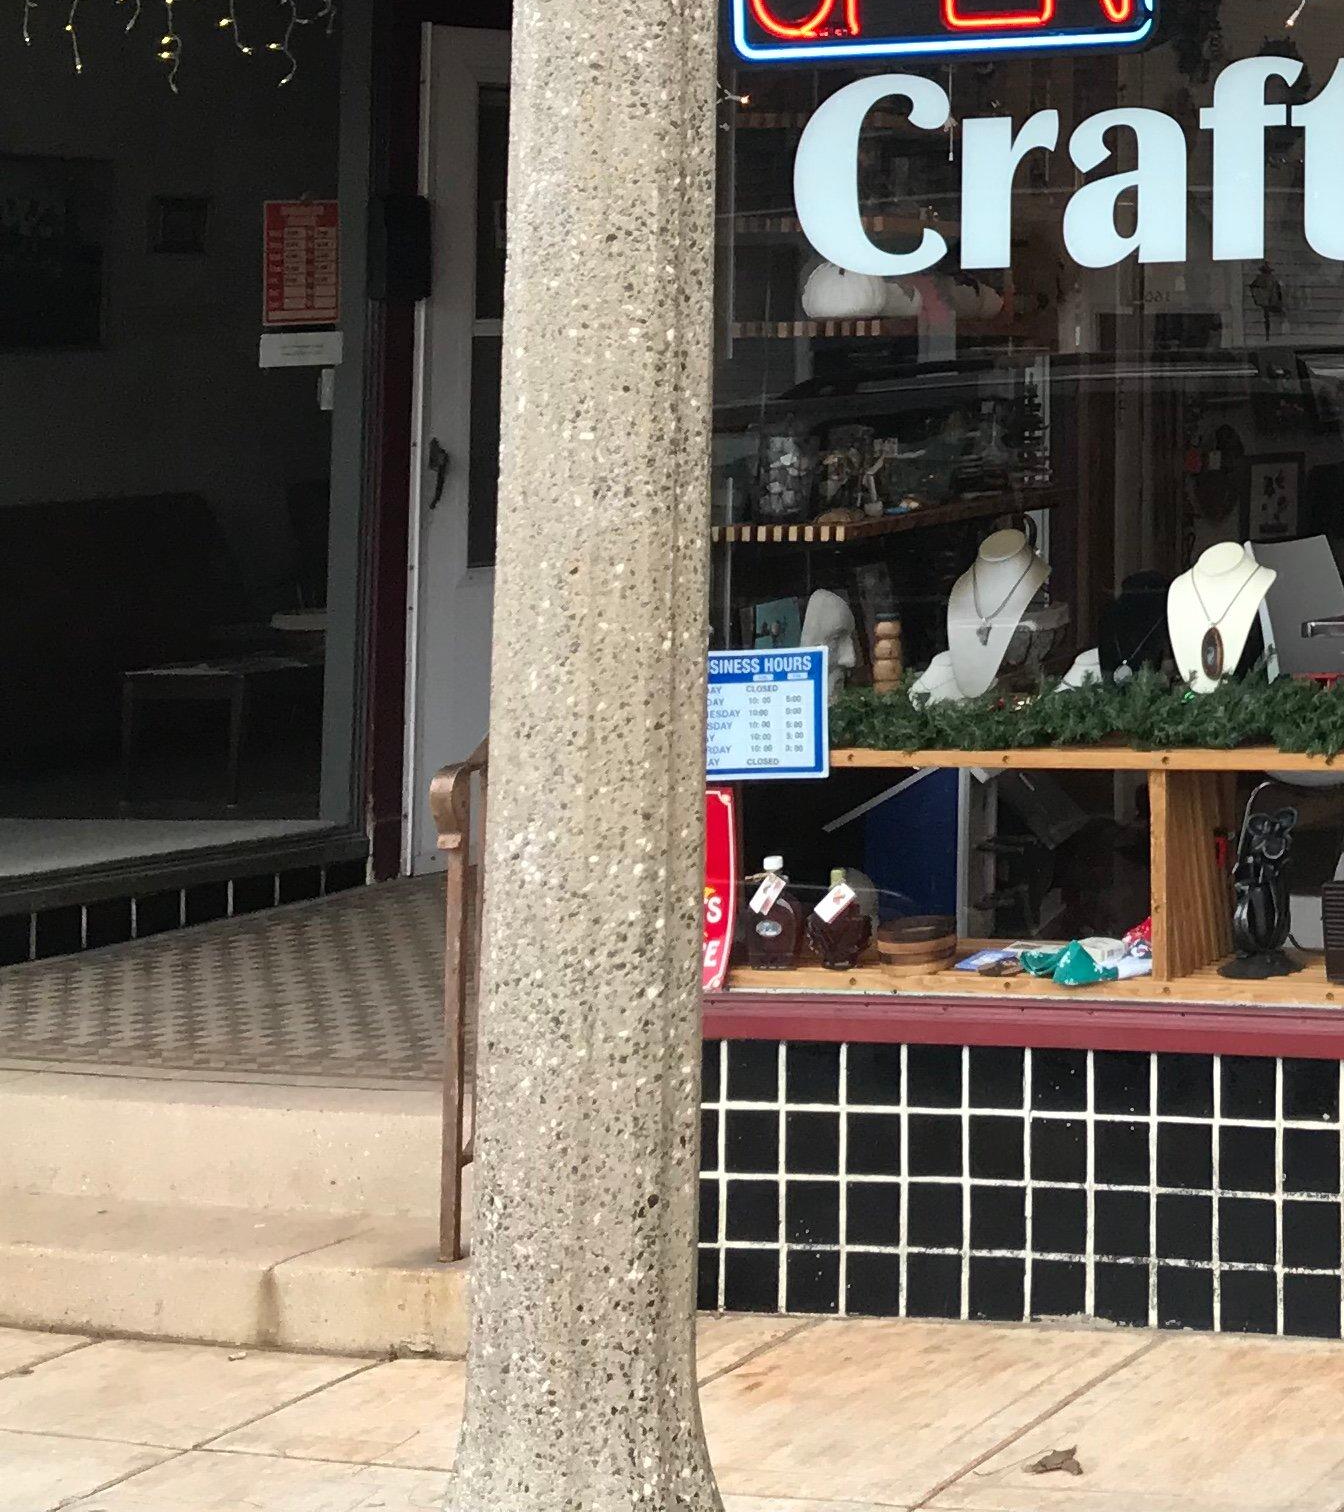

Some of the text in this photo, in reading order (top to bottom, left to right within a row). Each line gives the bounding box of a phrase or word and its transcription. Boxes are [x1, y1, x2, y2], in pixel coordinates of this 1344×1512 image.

[764, 655, 812, 672] HOURS
[746, 684, 779, 693] CLOSED
[746, 757, 779, 766] CLOSED
